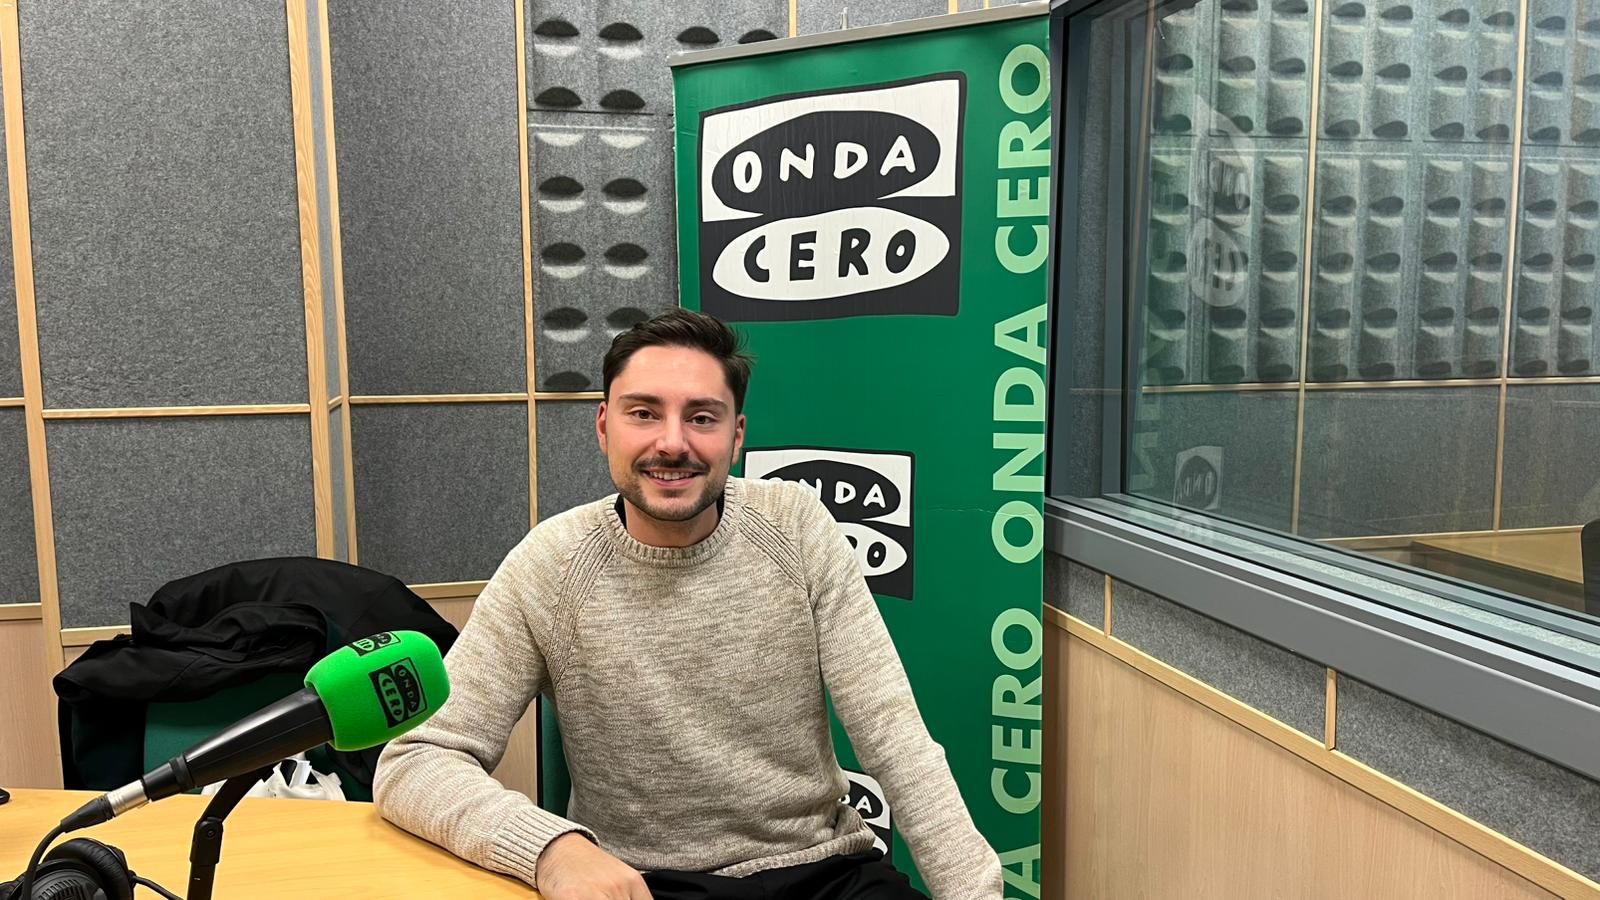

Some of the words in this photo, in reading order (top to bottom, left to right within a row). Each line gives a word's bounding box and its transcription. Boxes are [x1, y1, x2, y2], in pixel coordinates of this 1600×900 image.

[732, 135, 916, 193] ONDA
[995, 43, 1052, 274] CERO
[743, 228, 917, 283] CERO
[991, 303, 1048, 564] ONDA
[768, 477, 886, 508] NDA
[382, 677, 403, 717] CERO
[399, 668, 418, 709] ONDA
[991, 608, 1043, 815] CERO
